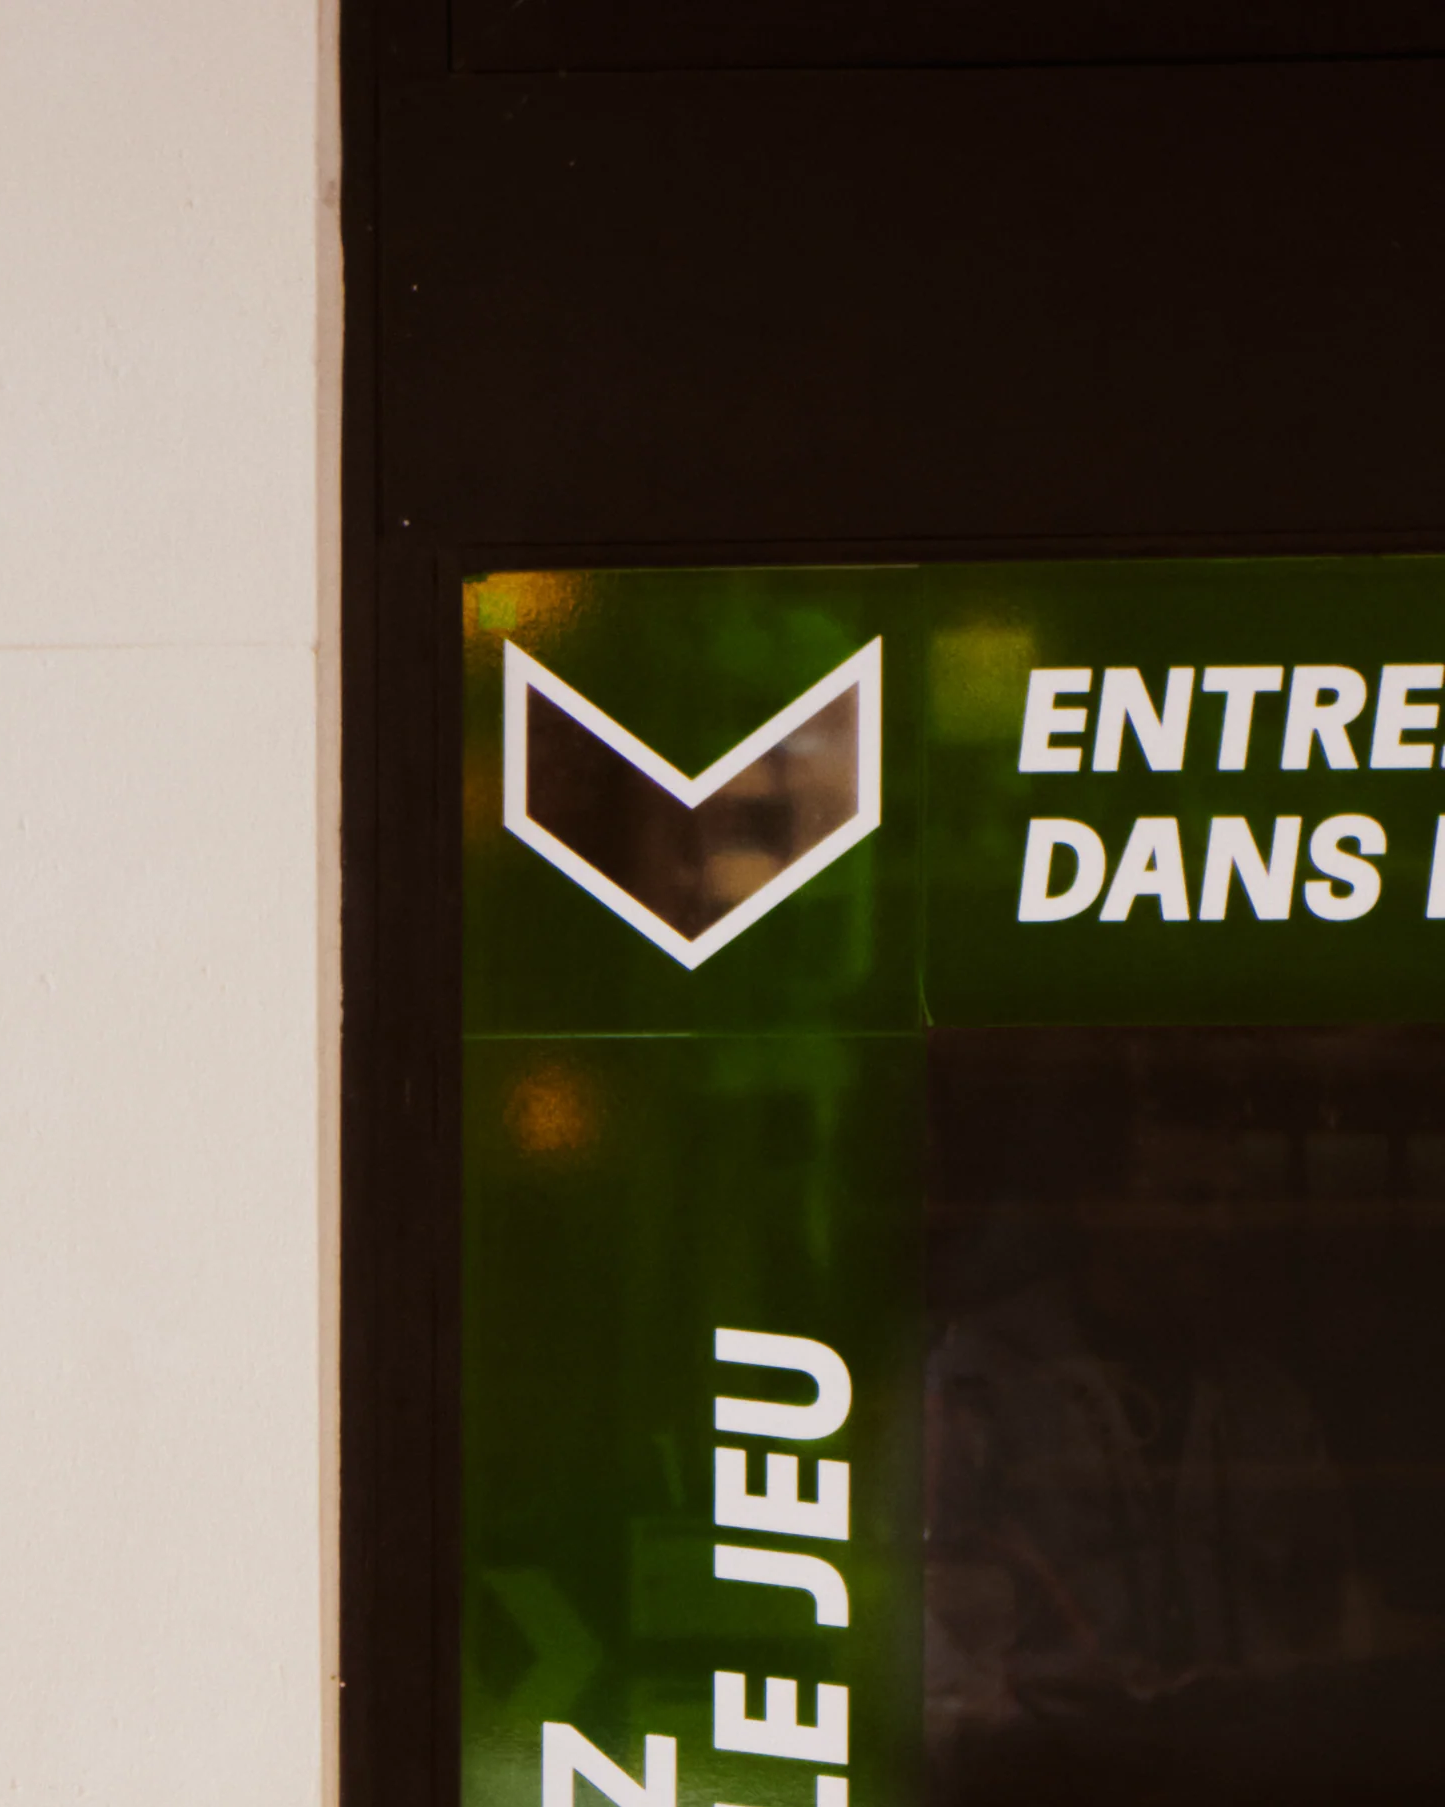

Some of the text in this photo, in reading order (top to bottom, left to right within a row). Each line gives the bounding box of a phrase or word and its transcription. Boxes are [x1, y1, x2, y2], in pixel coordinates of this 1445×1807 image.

[1017, 665, 1445, 772] ENTRE
[1017, 815, 1385, 922] DANS
[713, 1328, 852, 1627] JEU
